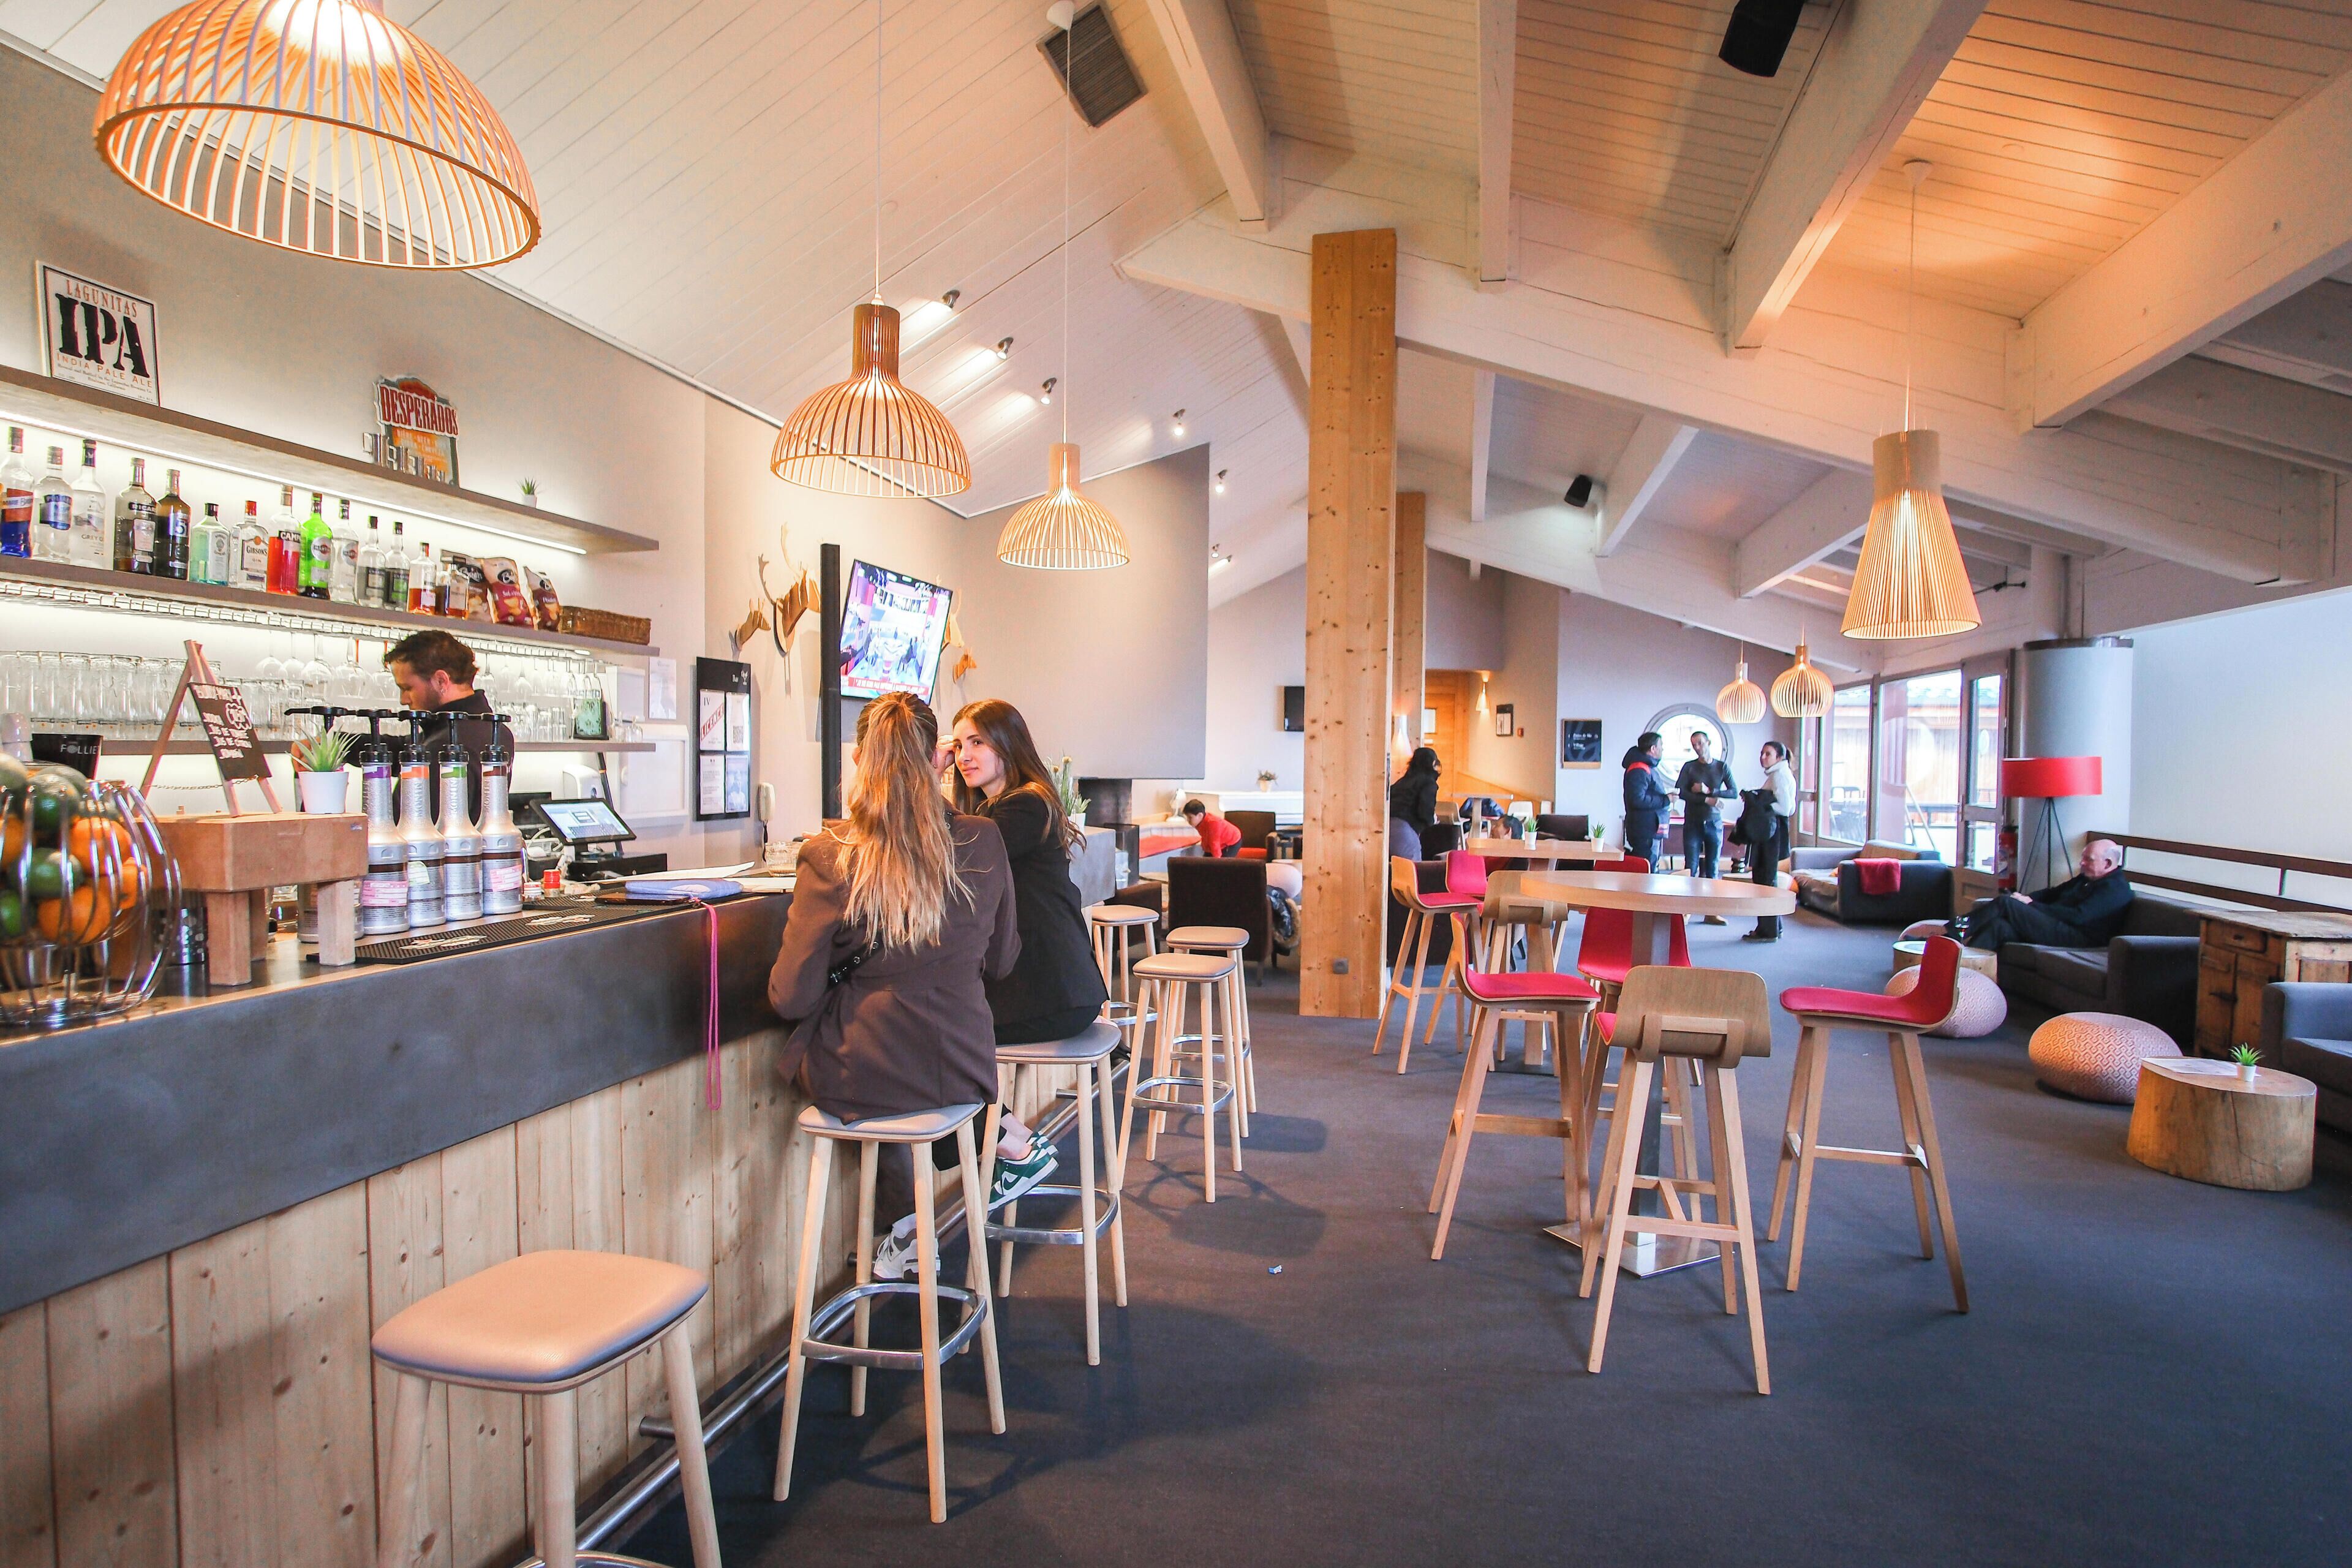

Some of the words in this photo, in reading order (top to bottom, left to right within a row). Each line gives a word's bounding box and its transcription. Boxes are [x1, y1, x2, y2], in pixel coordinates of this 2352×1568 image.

[66, 279, 137, 318] LAGUNITAS
[55, 293, 150, 379] IPA
[56, 352, 89, 369] INDIA
[97, 364, 126, 380] PALE
[132, 375, 152, 388] ALE
[380, 386, 458, 435] DESPERADOS
